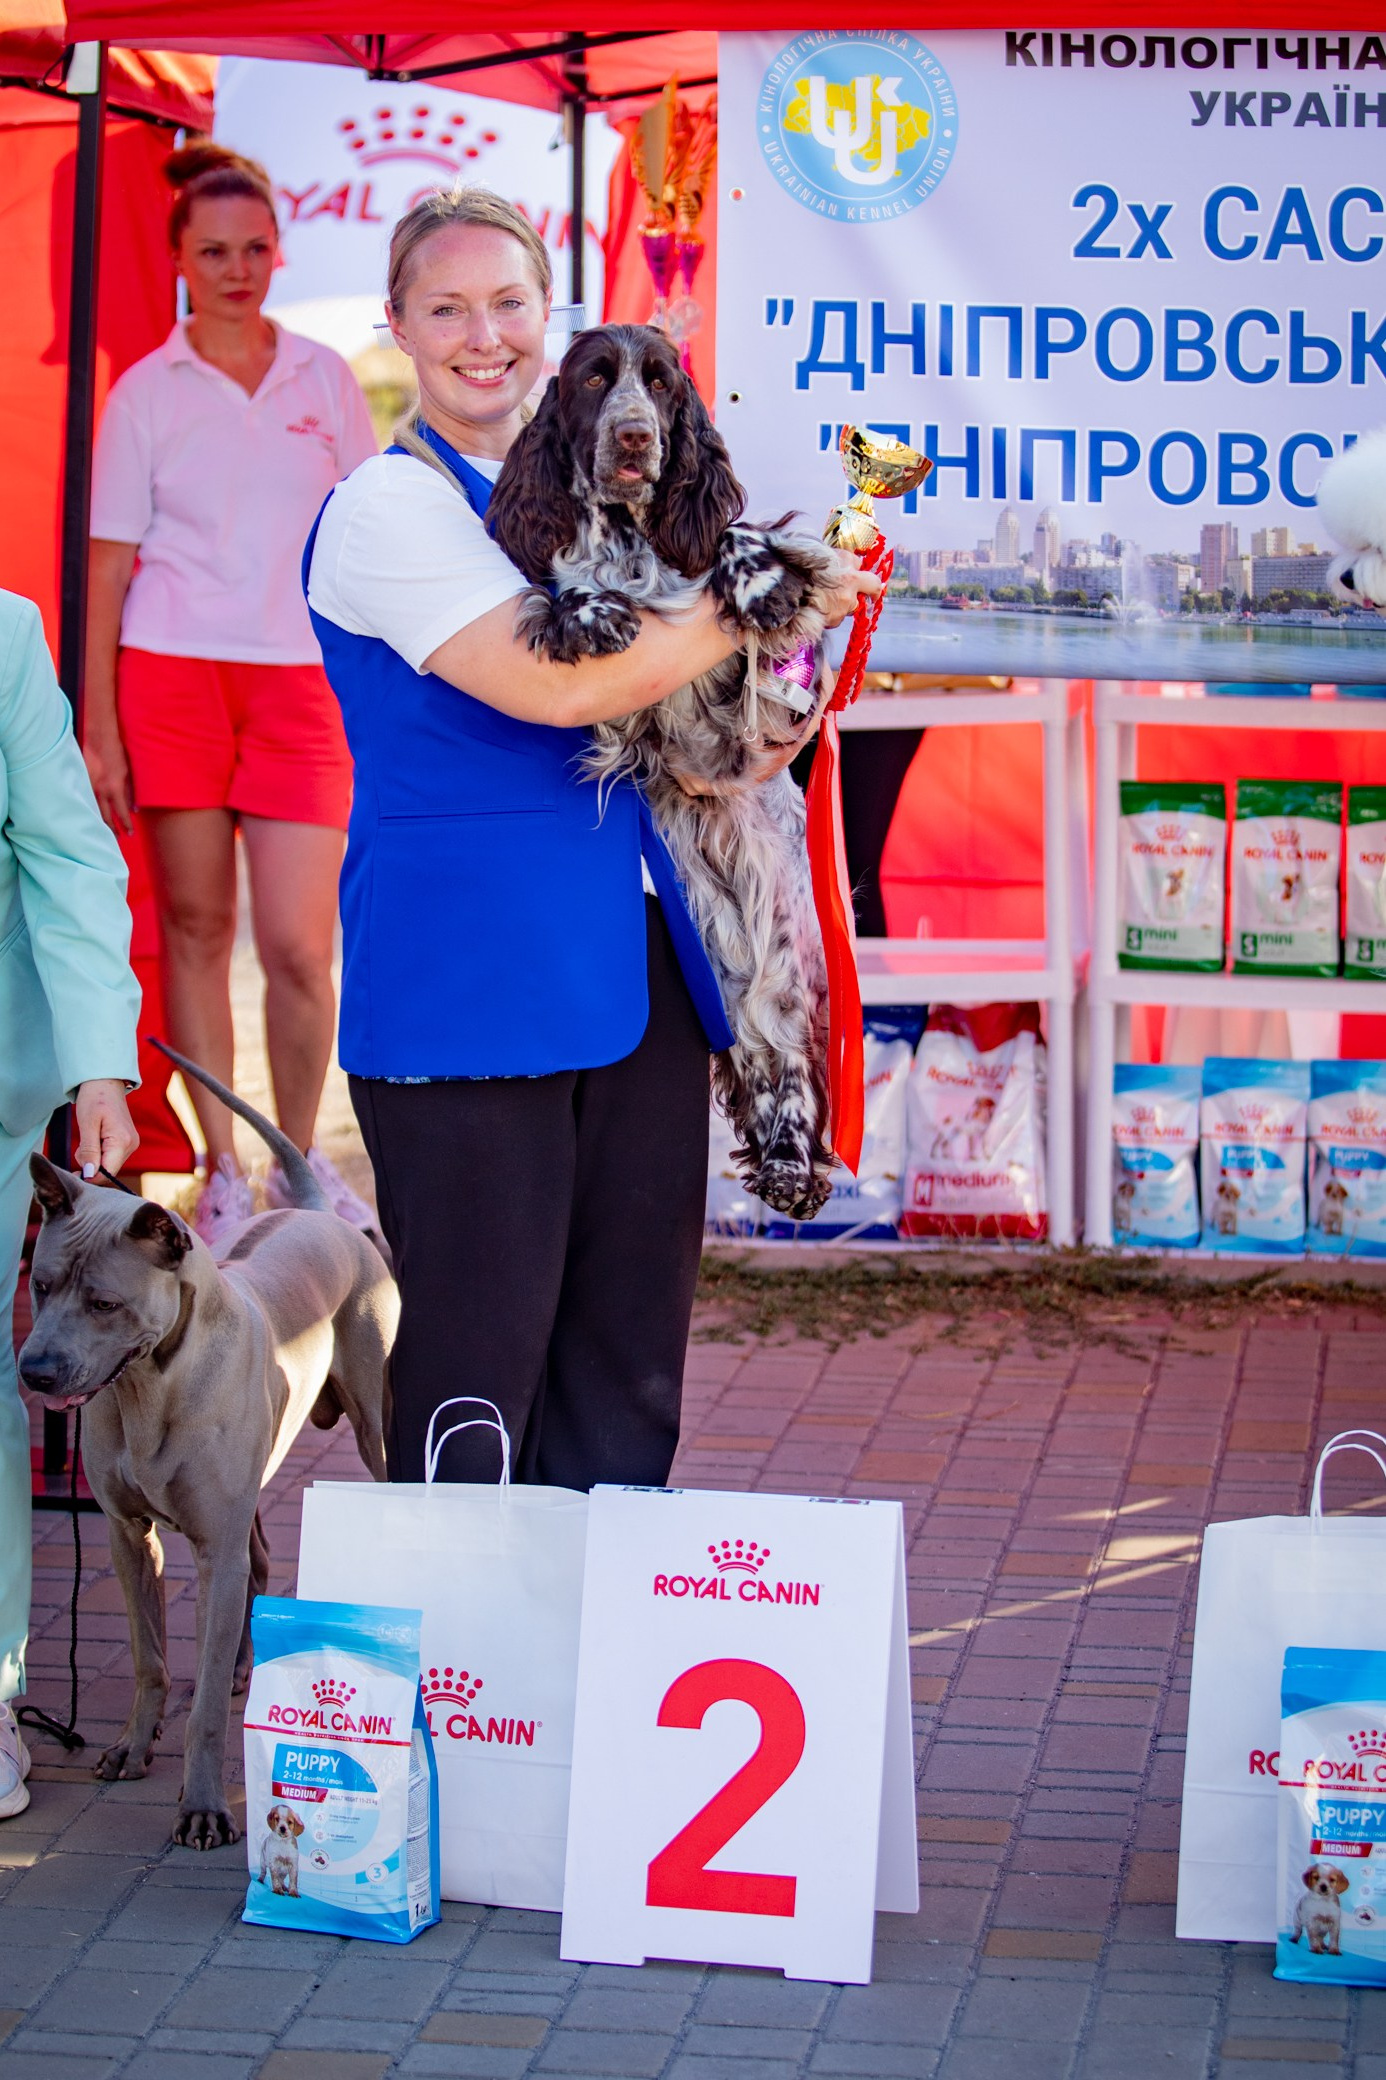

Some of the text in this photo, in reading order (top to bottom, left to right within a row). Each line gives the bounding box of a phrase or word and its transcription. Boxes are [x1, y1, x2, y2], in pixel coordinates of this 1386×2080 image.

[1004, 30, 1386, 71] КІНОЛОГІЧНА
[763, 140, 951, 221] UKRAINIAN KENNEL UNION
[653, 1574, 820, 1606] ROYAL CANIN
[267, 1704, 392, 1736] ROYAL CANIN
[446, 1713, 535, 1747] CANIN
[283, 1770, 302, 1781] 2-12
[285, 1751, 340, 1773] PUPPY
[281, 1786, 317, 1800] MEDIUM
[645, 1657, 807, 1918] 2
[1323, 1806, 1385, 1826] PUPPY
[1321, 1843, 1361, 1855] MEDIUM
[373, 1867, 381, 1878] 3
